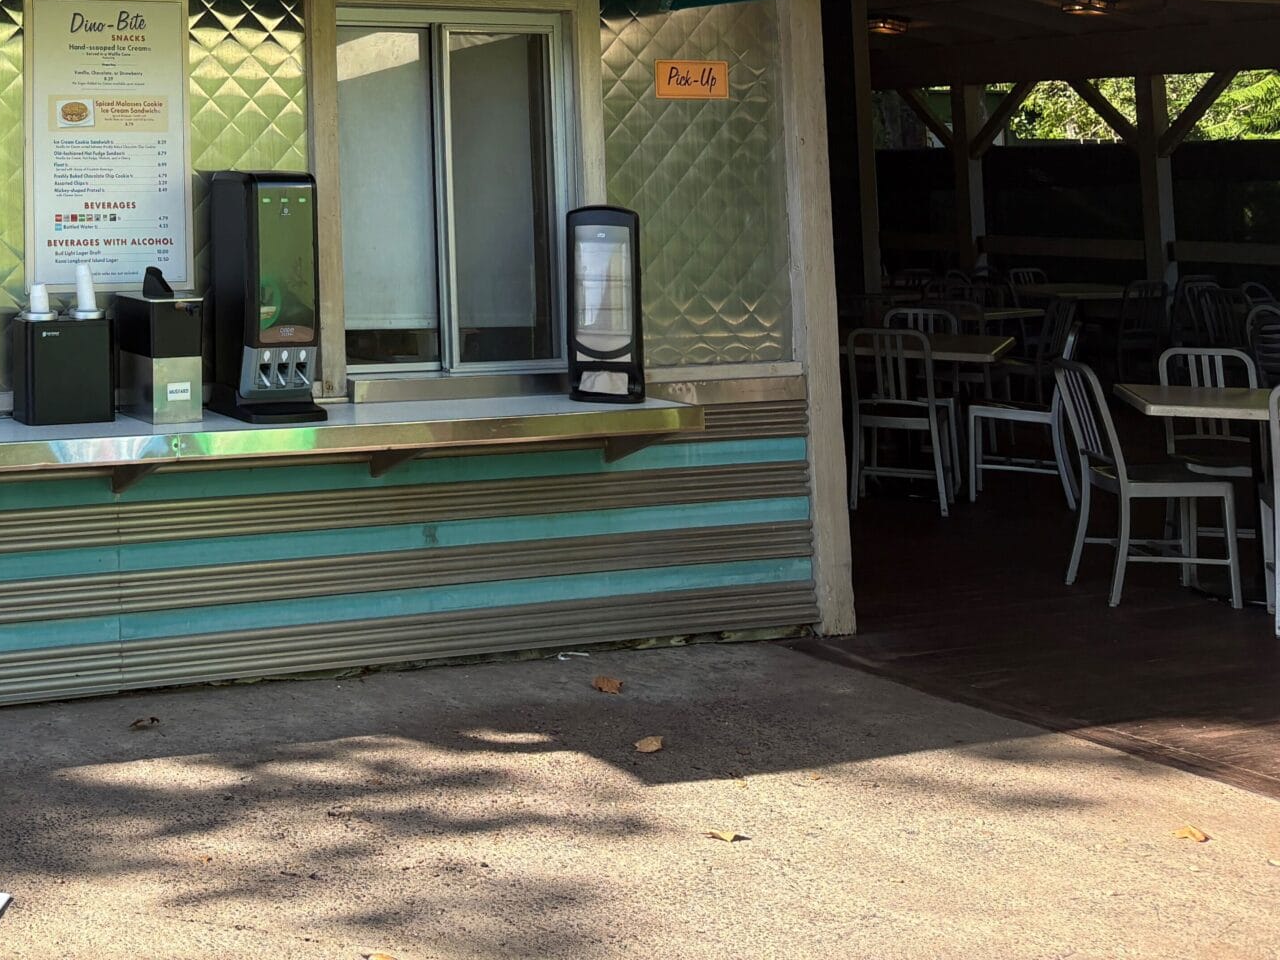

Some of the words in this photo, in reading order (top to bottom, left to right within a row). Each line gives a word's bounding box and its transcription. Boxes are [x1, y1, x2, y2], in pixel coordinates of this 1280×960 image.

[70, 10, 147, 33] Dino-Bite
[111, 34, 146, 42] SNACKS
[667, 66, 717, 93] Pick-Up
[47, 239, 100, 247] BEVERAGES
[131, 238, 174, 246] ALCOHOL
